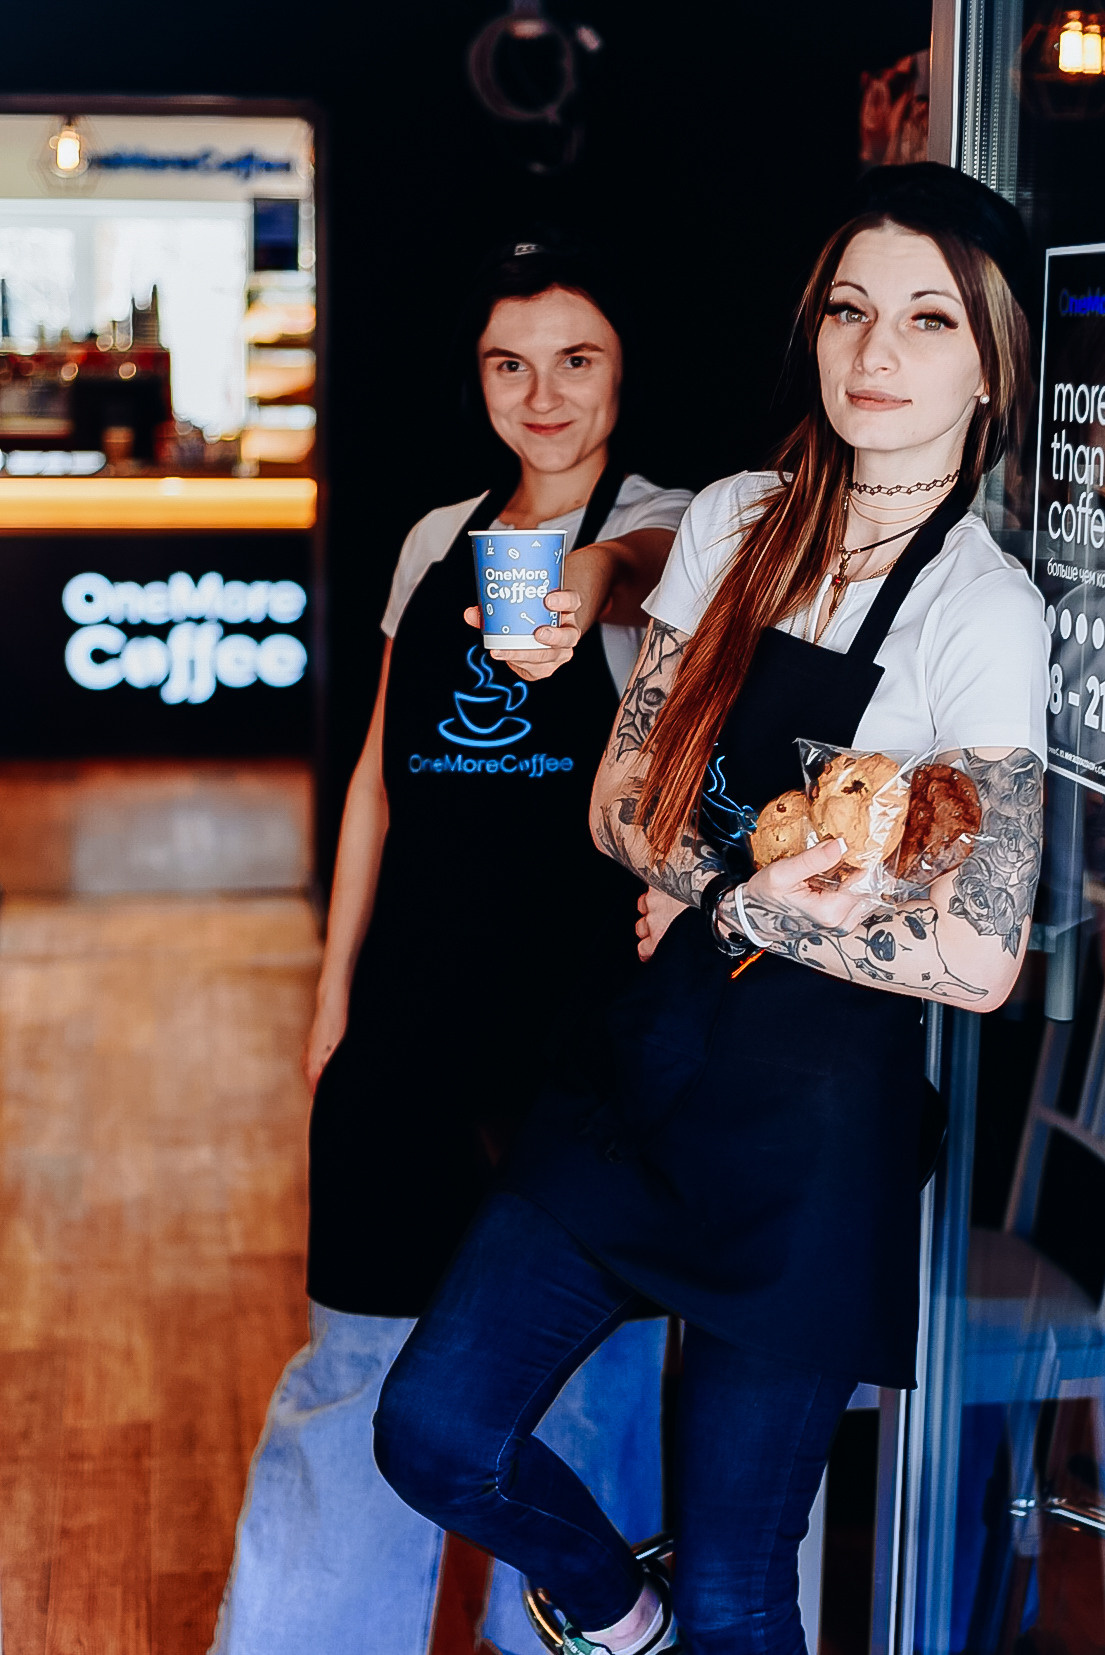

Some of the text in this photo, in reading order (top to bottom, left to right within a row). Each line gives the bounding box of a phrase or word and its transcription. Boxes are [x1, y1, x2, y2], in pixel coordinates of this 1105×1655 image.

[1053, 382, 1105, 427] more
[1050, 428, 1105, 487] than
[485, 568, 549, 581] OneMore
[1046, 556, 1079, 582] больше
[62, 571, 307, 625] OneMore
[486, 581, 550, 604] Coffee
[64, 619, 308, 705] Coffee
[409, 753, 574, 778] OneMoreCoffee
